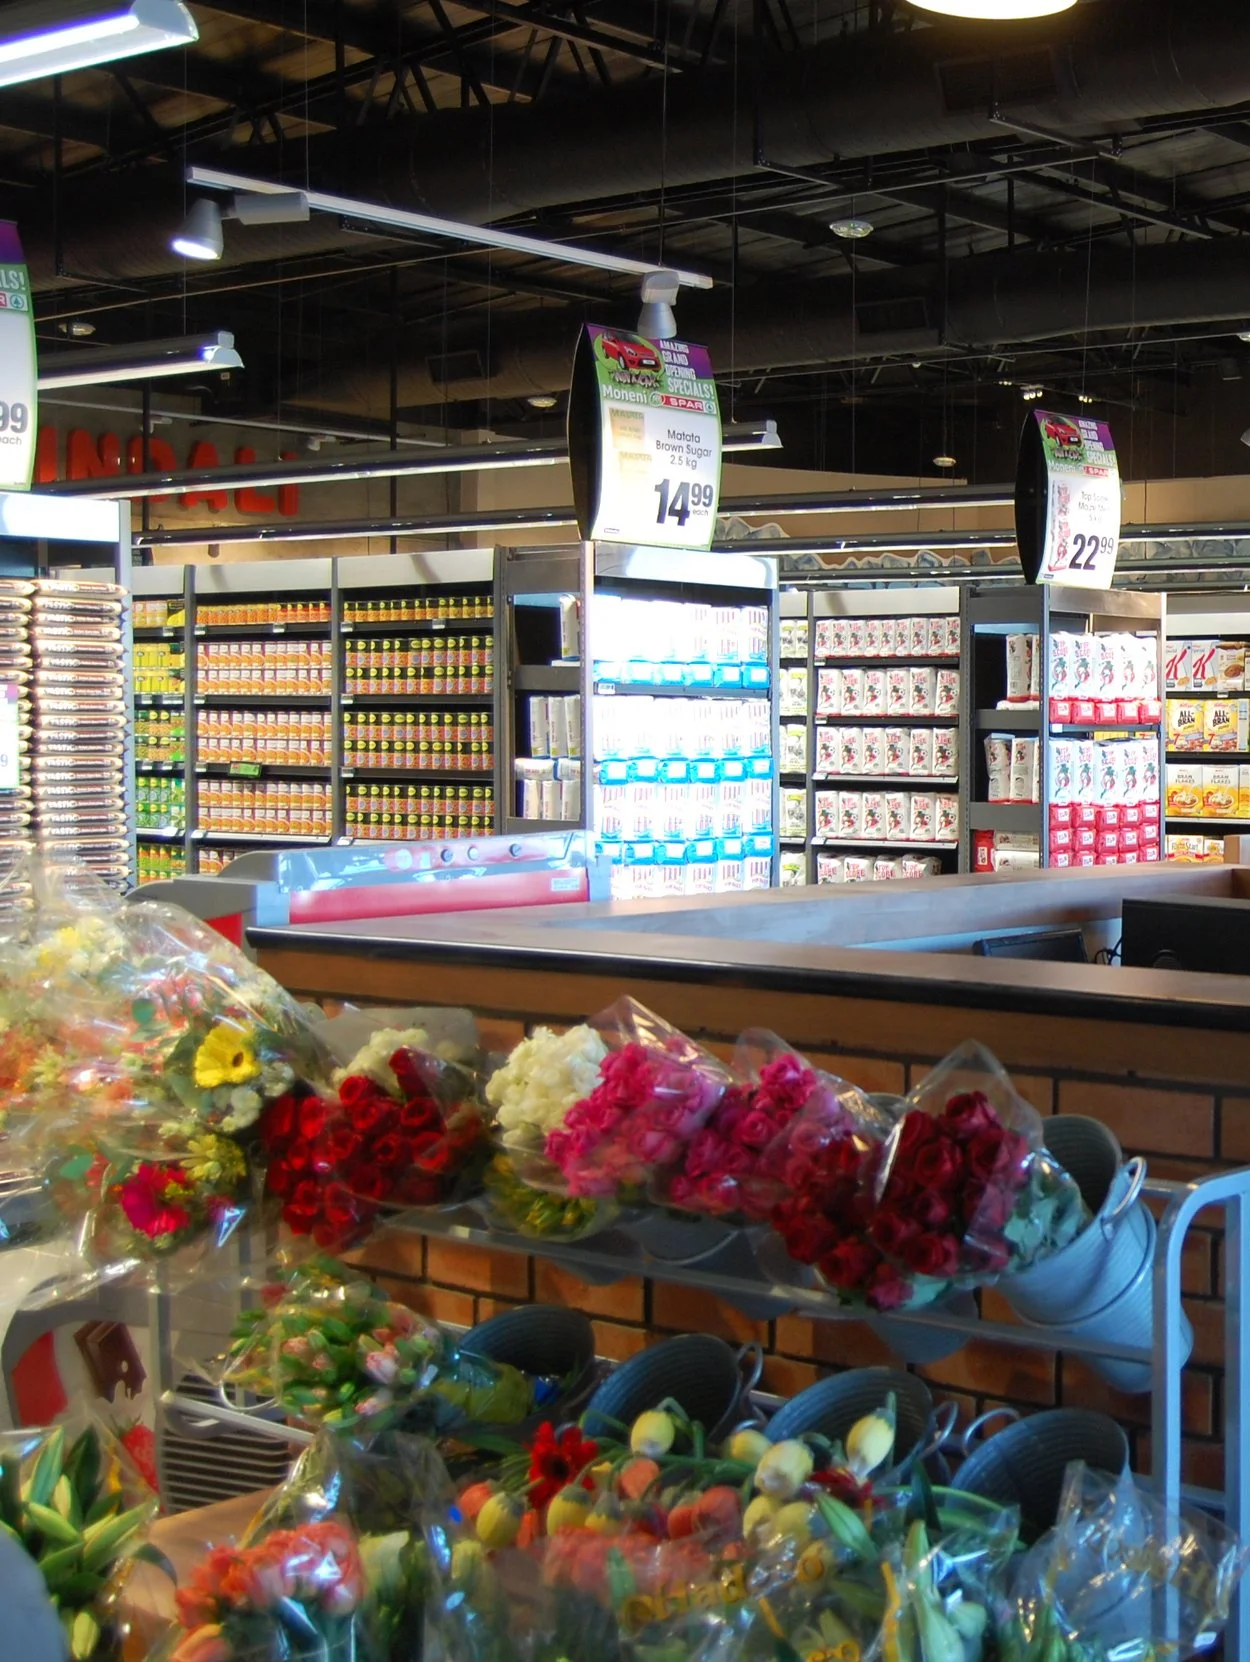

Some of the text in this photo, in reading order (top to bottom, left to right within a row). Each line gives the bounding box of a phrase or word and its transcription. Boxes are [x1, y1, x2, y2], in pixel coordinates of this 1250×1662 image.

[602, 384, 648, 404] Moneni
[667, 378, 715, 400] SPECIALS!
[669, 397, 704, 410] SPAR
[667, 429, 701, 443] Matata
[656, 440, 713, 458] Brown Sugar
[670, 455, 698, 470] 2.5 kg
[1177, 717, 1196, 728] BRAN
[1212, 717, 1231, 728] BRAN
